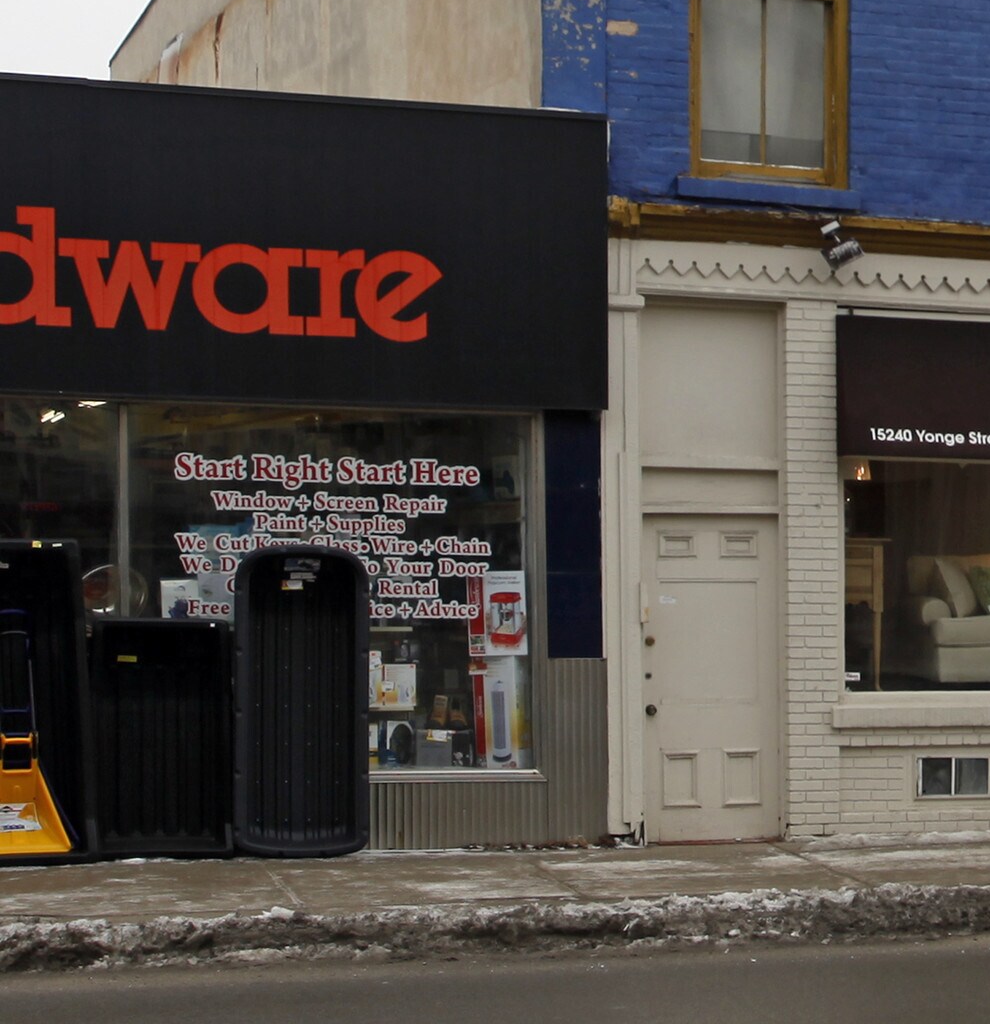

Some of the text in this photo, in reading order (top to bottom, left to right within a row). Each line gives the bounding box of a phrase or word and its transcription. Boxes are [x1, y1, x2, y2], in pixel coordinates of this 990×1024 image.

[0, 206, 443, 342] dware
[870, 427, 912, 442] 15240
[915, 429, 965, 447] Yonge
[174, 452, 480, 490] Start Right Start Here
[211, 490, 294, 511] Window
[314, 492, 379, 513] Screen
[383, 494, 447, 518] Repair
[253, 513, 307, 532] Paint
[326, 514, 406, 537] Supplies
[174, 532, 207, 553] We
[214, 533, 250, 553] Cut
[435, 536, 492, 556] Chain
[179, 555, 213, 574] We
[383, 557, 433, 576] Your
[438, 558, 489, 577] Door
[378, 578, 439, 598] Rental
[187, 598, 231, 617] Free
